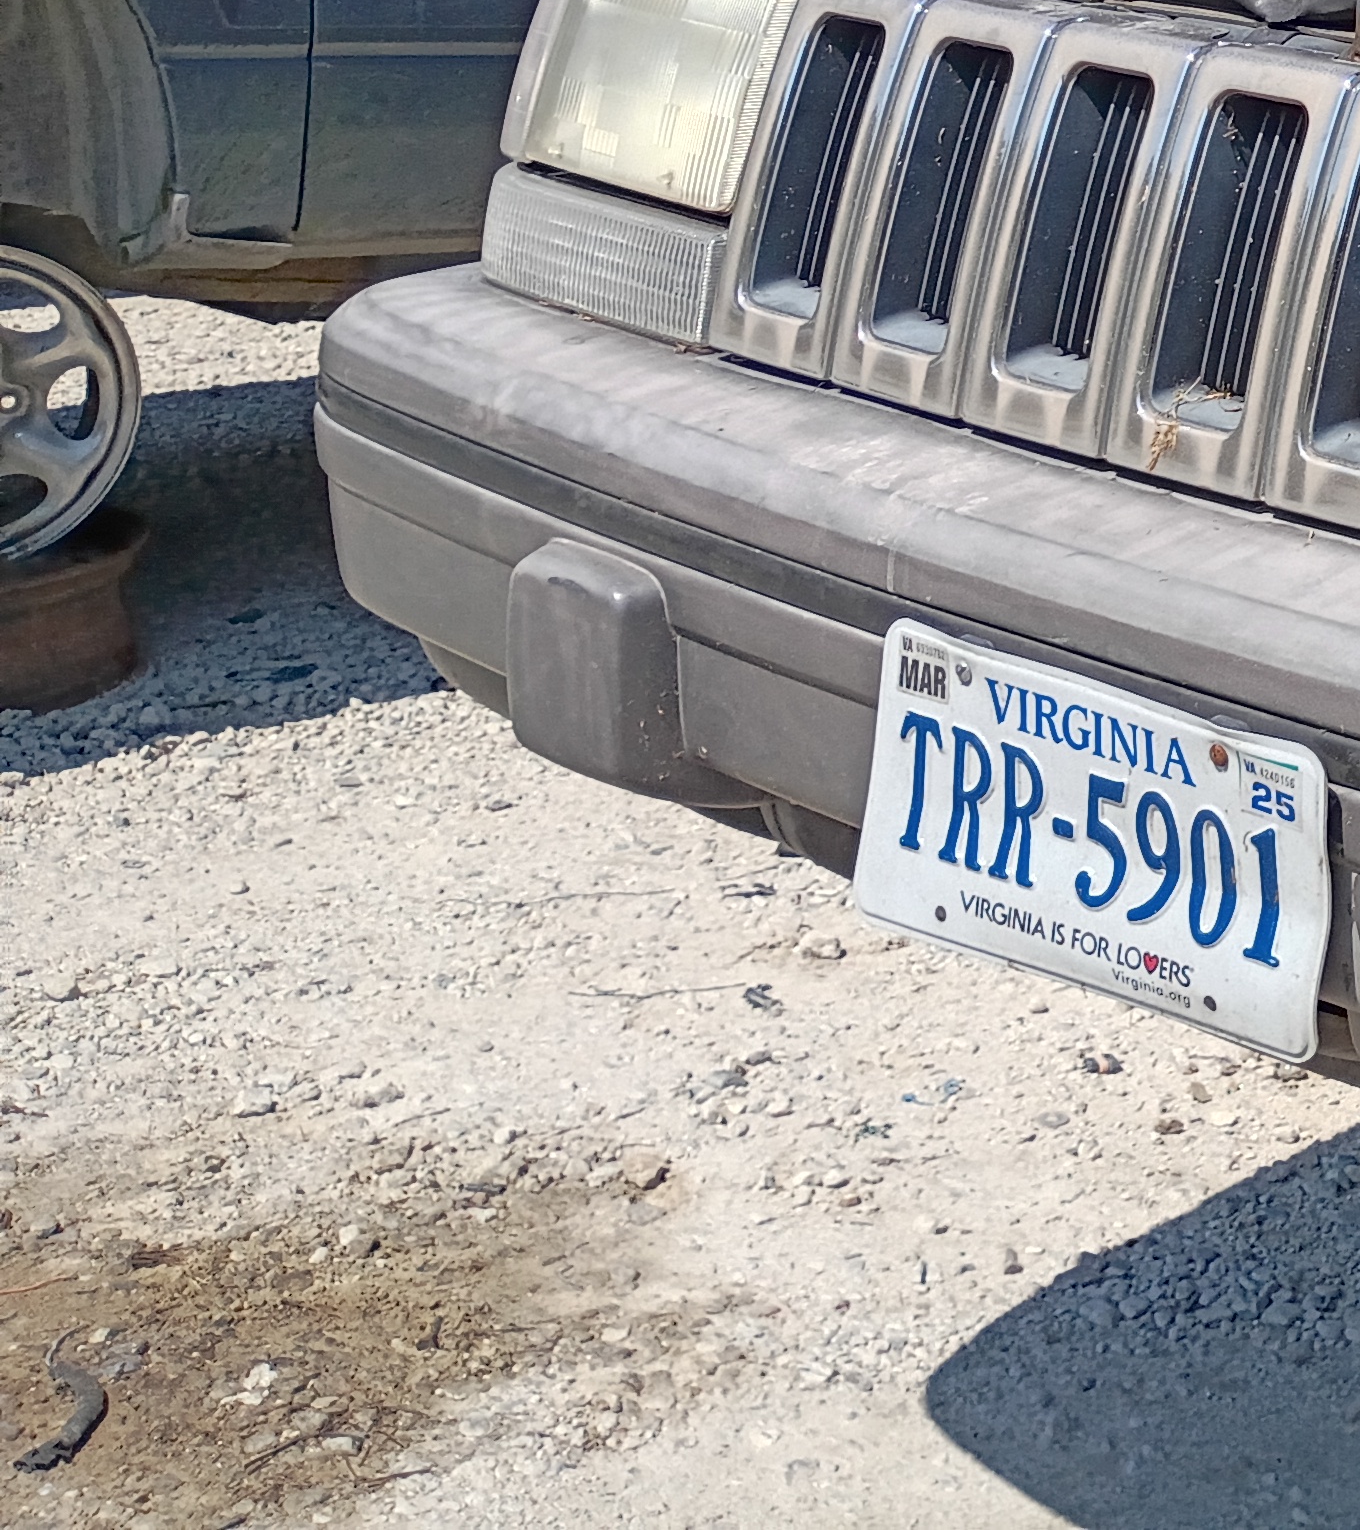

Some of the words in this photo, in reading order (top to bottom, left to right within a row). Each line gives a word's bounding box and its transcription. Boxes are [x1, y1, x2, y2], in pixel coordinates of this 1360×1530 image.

[899, 656, 947, 699] MAR
[984, 678, 1196, 787] VIRGINIA
[1251, 781, 1296, 822] 25
[899, 711, 1281, 968] TRR-5901
[960, 890, 1046, 940] VIRGINIA
[1051, 921, 1066, 945] IS
[1071, 928, 1112, 962] FOR
[1111, 967, 1192, 1009] Virginia.org
